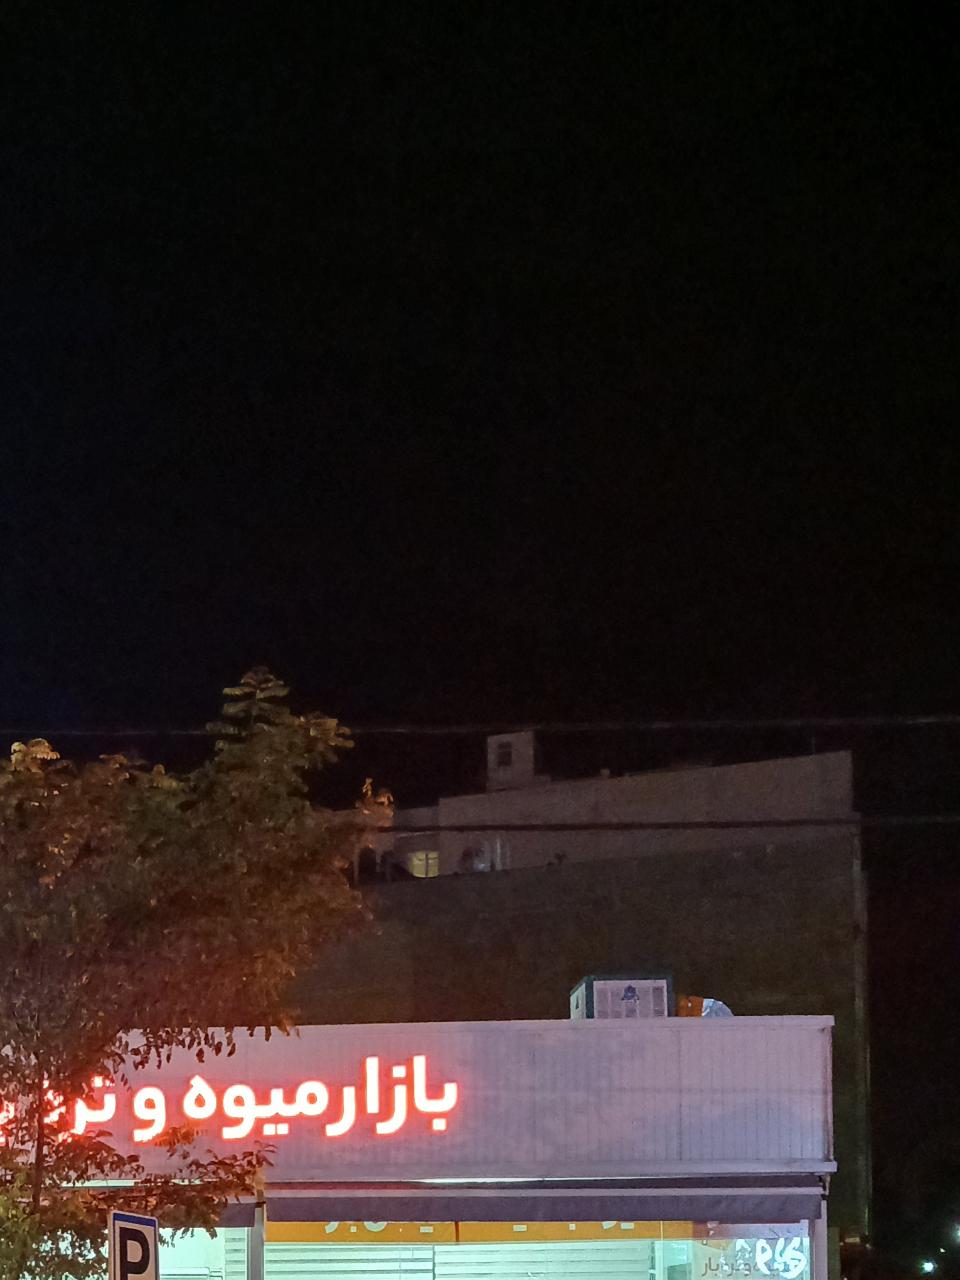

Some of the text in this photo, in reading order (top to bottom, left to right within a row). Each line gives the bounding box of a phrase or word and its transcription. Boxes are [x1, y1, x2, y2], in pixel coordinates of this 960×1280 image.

[132, 1085, 167, 1142] و
[181, 1074, 330, 1141] میوه
[324, 1053, 459, 1137] بازار
